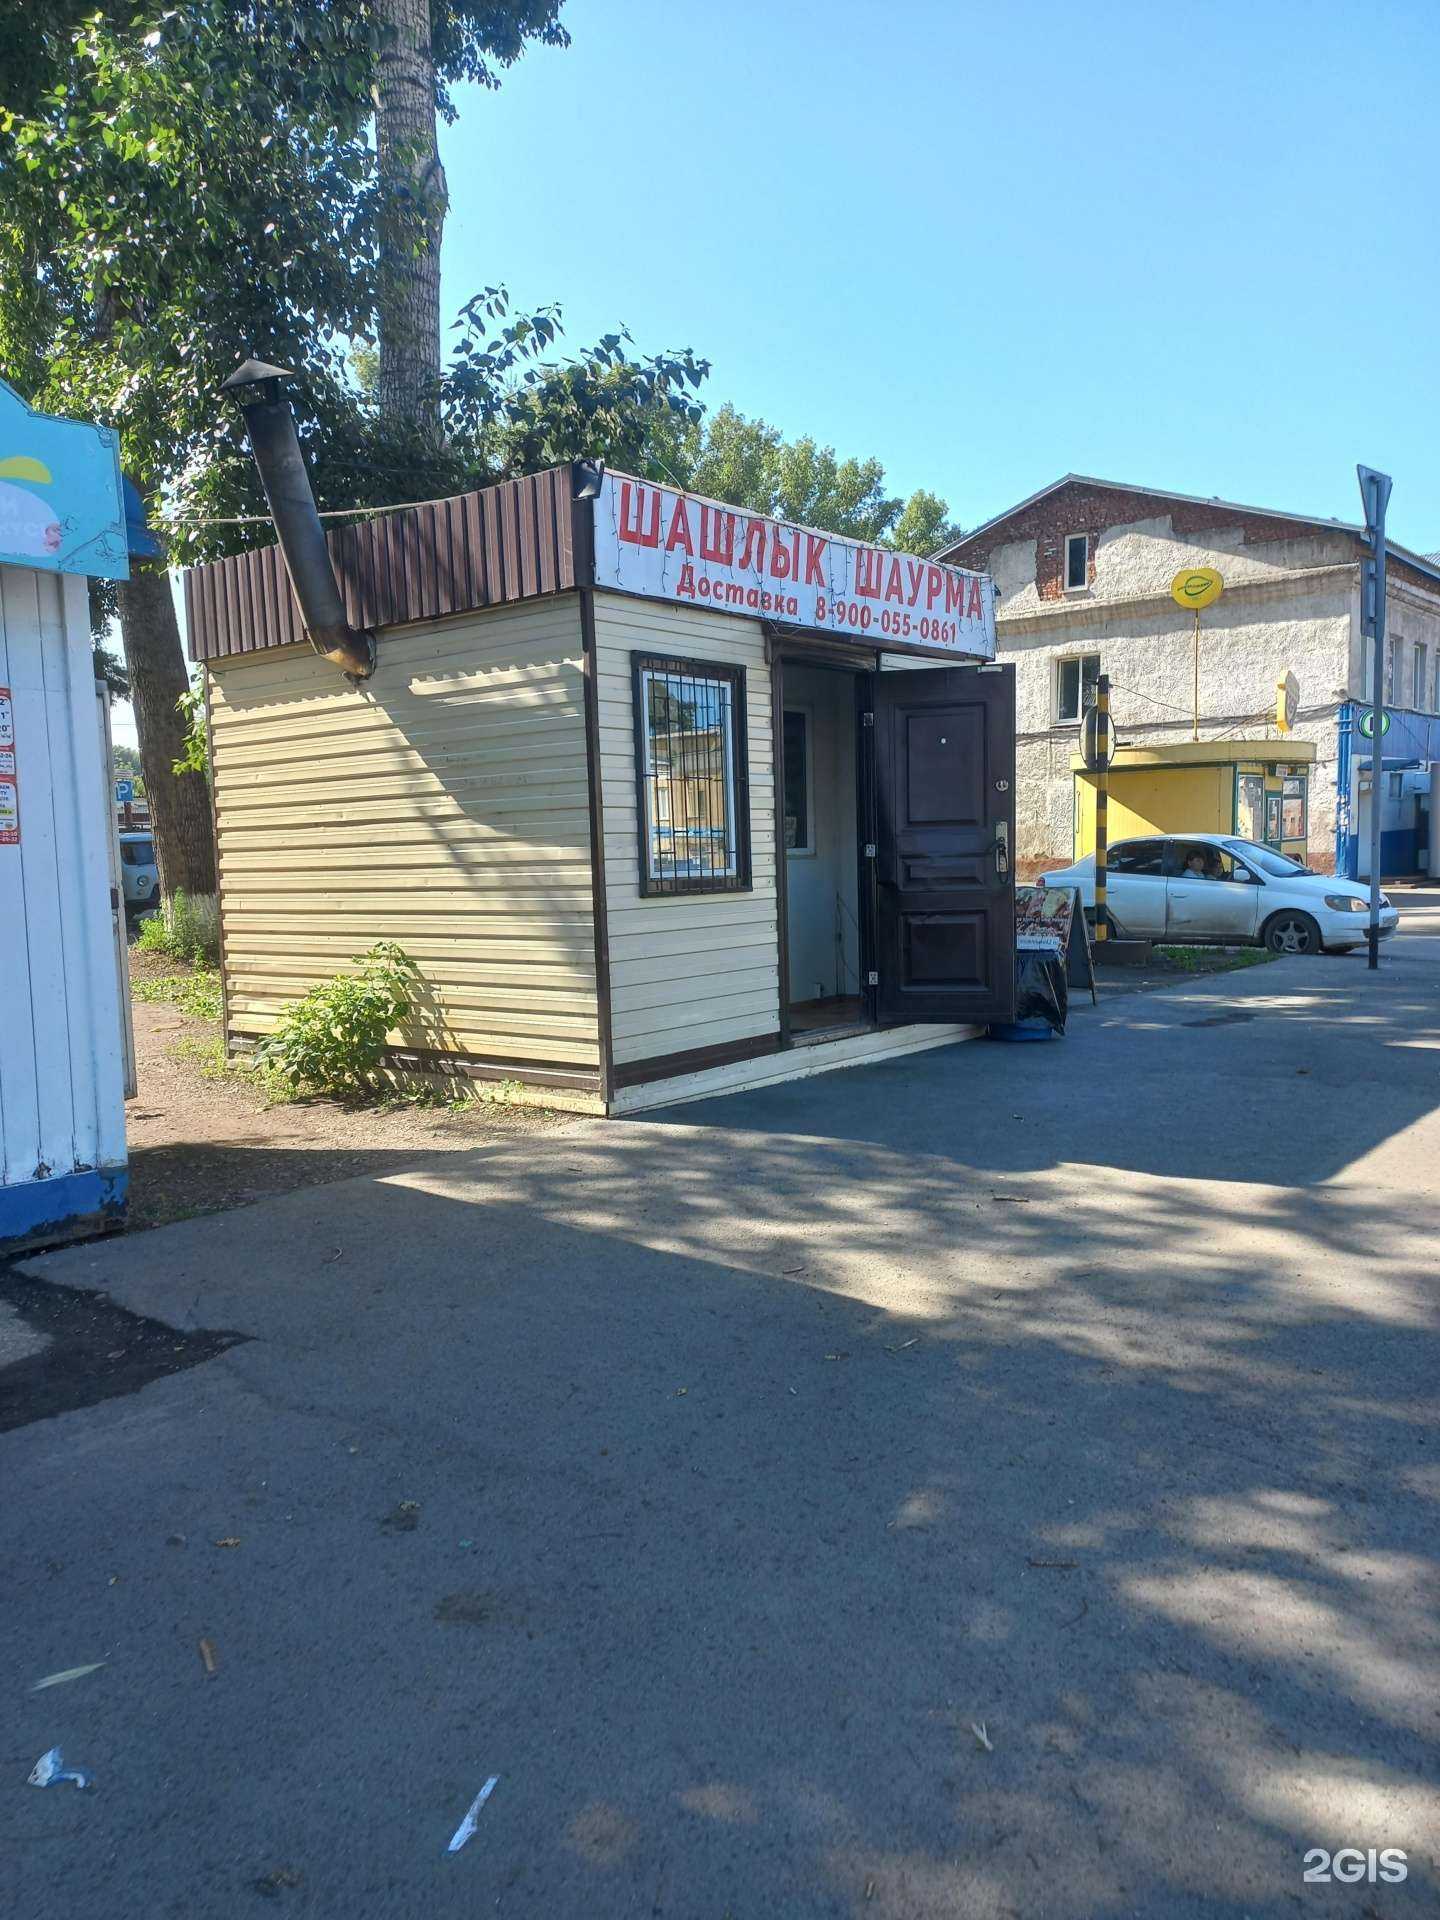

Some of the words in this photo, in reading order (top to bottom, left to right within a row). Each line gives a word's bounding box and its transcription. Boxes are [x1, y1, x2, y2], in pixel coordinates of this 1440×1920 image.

[619, 482, 829, 587] ШАШЛЫК
[855, 546, 983, 620] ШАУРМА
[676, 563, 799, 616] Доставка
[815, 595, 956, 644] 8-900-055-0861
